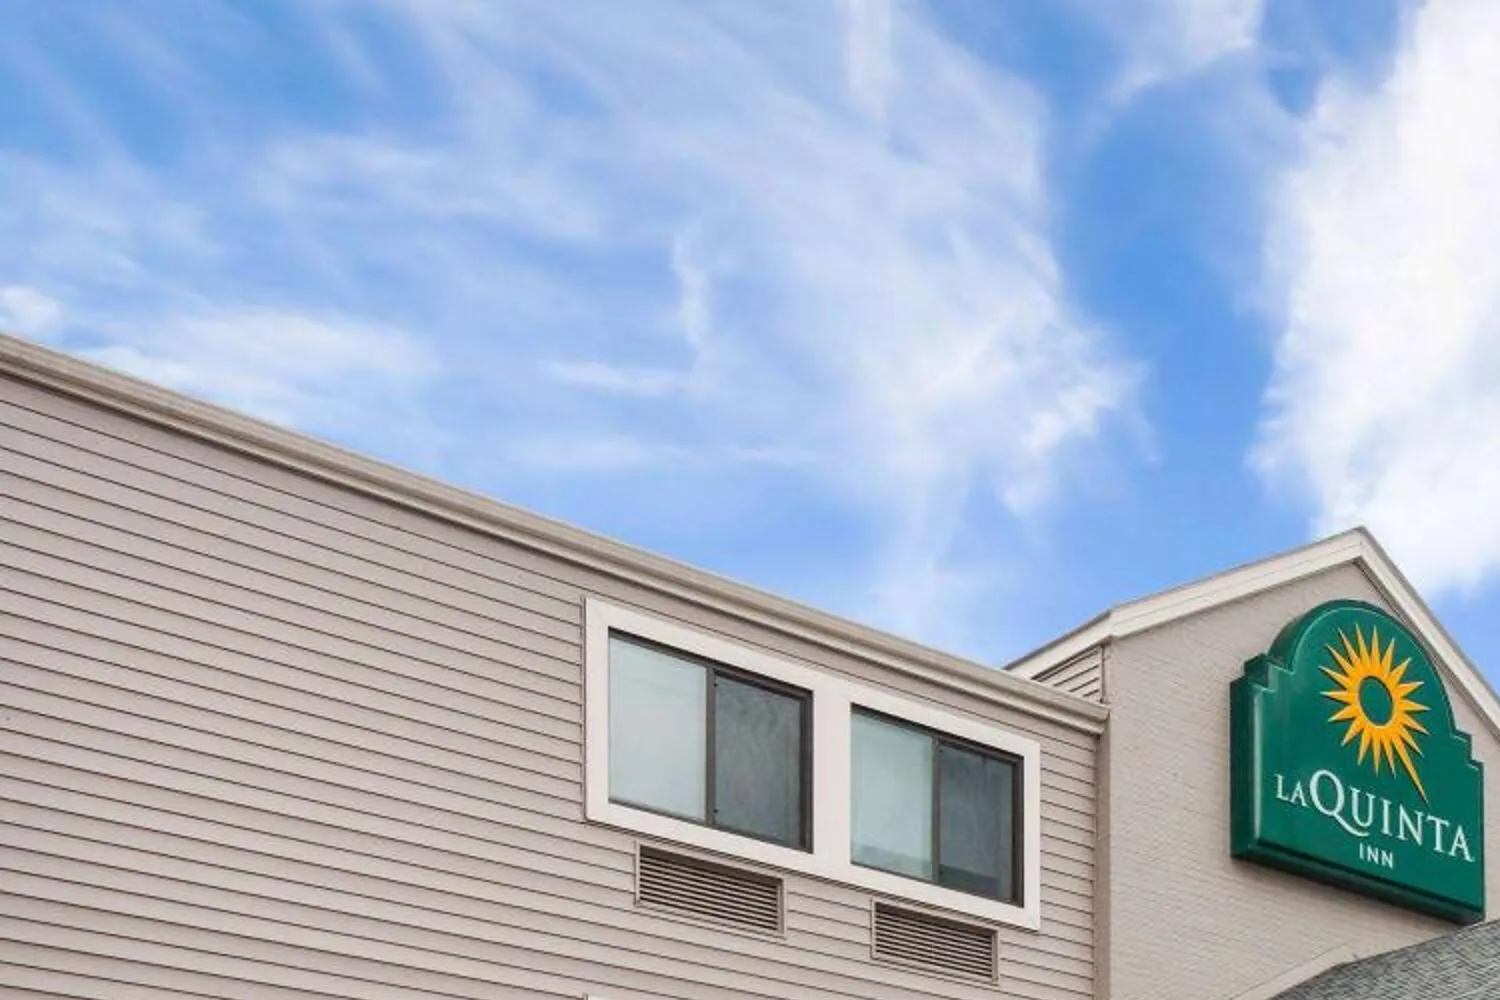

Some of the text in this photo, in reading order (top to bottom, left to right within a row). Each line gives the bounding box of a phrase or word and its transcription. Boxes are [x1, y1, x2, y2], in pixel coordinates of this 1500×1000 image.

[1275, 768, 1475, 863] LA QUINTA
[1358, 842, 1395, 870] INN
